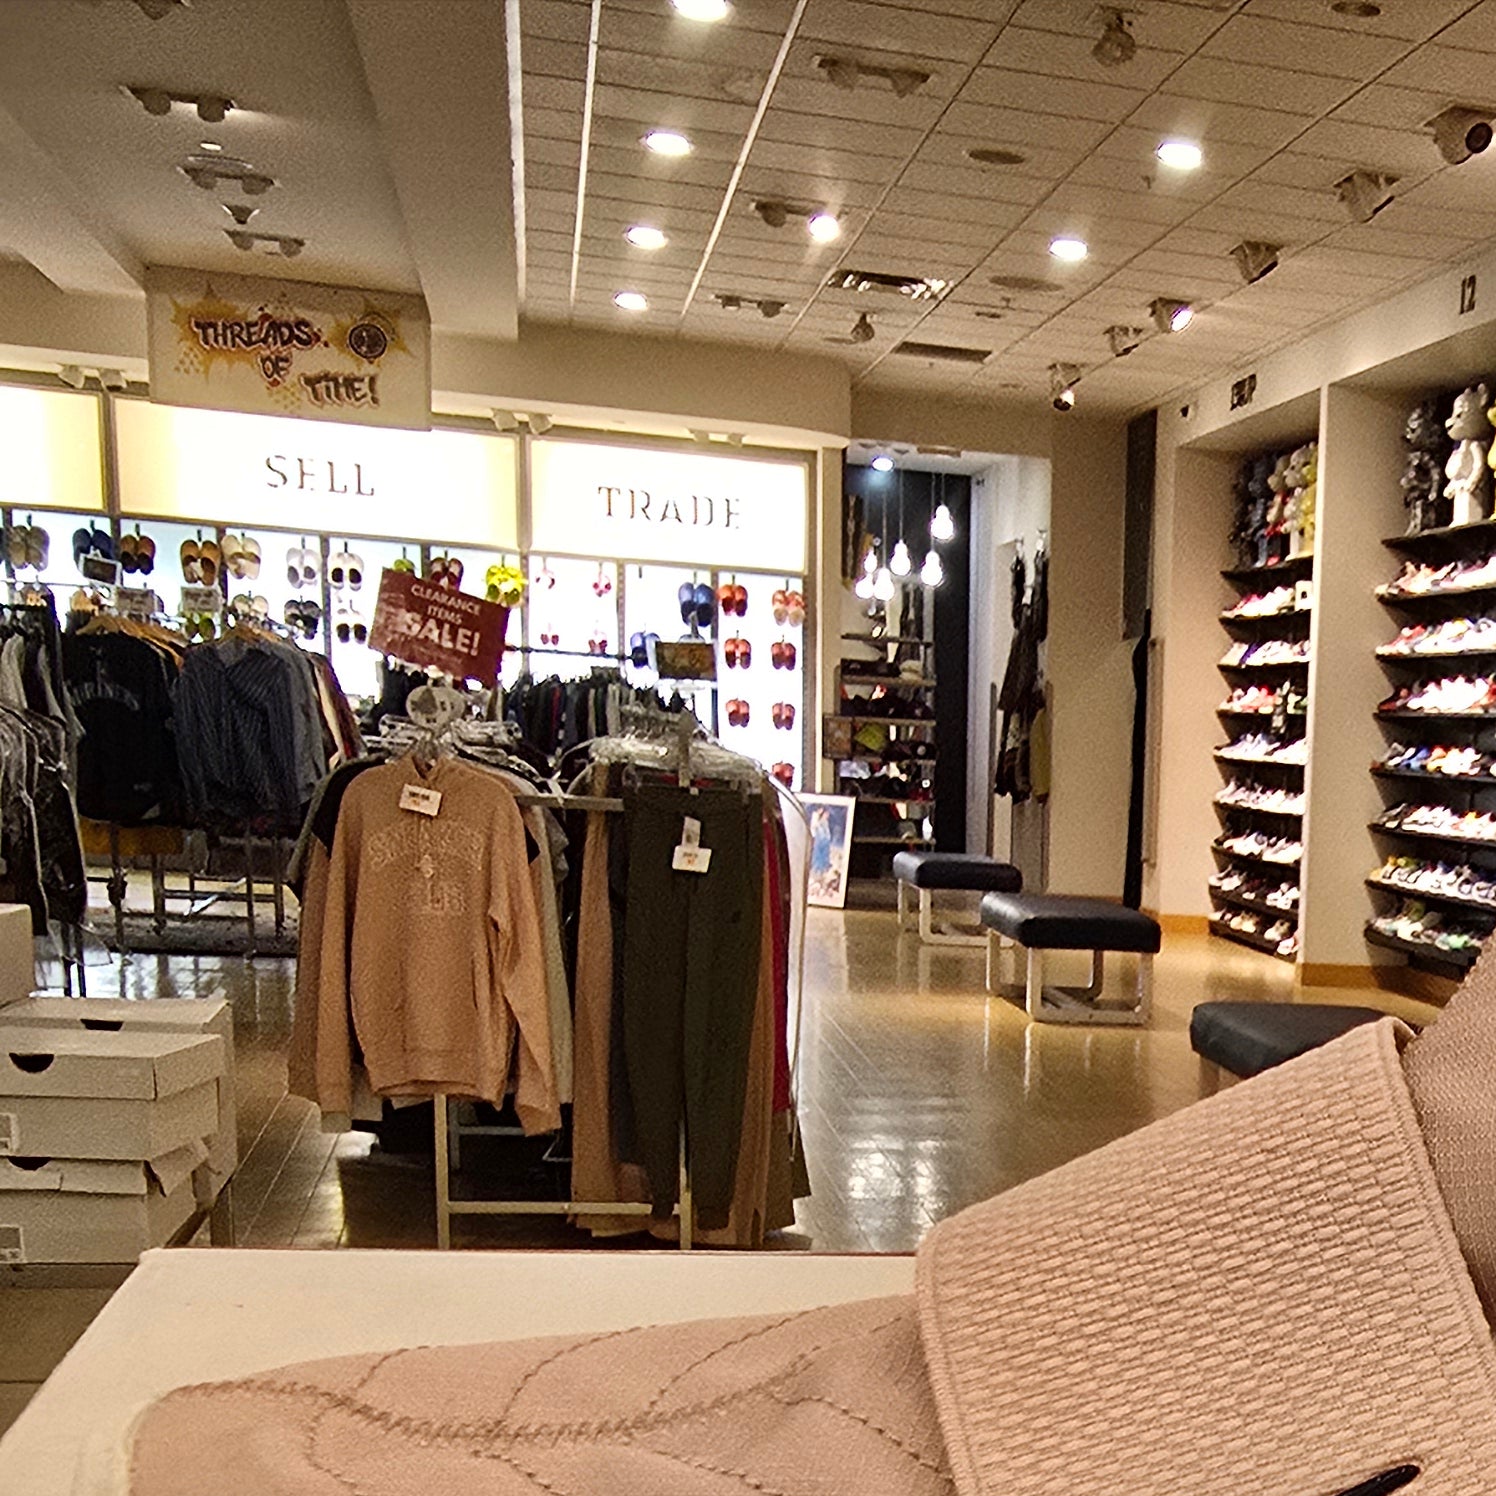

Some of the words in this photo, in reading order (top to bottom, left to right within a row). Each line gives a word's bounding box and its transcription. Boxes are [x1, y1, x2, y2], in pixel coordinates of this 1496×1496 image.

[1459, 274, 1477, 315] 12
[193, 317, 314, 348] THREADS
[261, 353, 291, 380] OF
[265, 455, 375, 497] SELL
[598, 486, 741, 530] TRADE
[411, 583, 480, 616] CLEARANCE
[427, 605, 462, 625] ITEMS
[401, 610, 480, 657] SALE!
